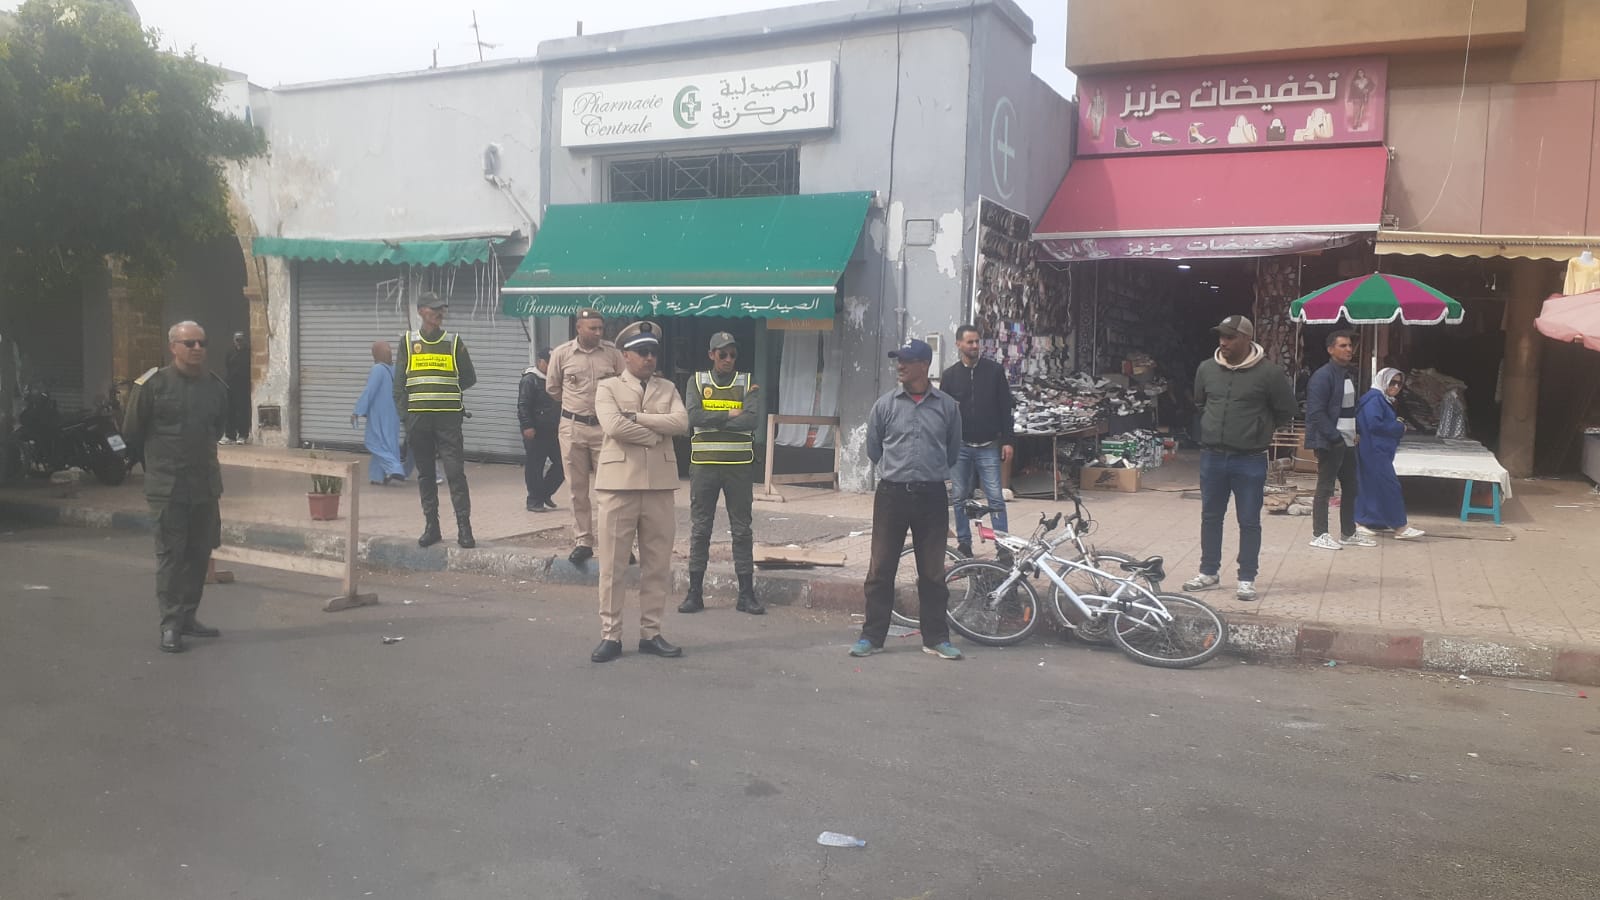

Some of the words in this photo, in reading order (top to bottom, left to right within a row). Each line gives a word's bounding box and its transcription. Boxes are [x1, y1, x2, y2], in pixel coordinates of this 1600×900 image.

[719, 69, 809, 100] الصيدلية
[1190, 71, 1340, 111] تخفيضات
[572, 91, 664, 116] Pharmacie
[711, 91, 816, 129] المركزية
[1120, 83, 1181, 118] عزيز
[580, 113, 652, 137] Centrale
[1124, 242, 1174, 256] عزيز
[1187, 237, 1294, 253] تخفيضات
[588, 294, 644, 314] Centrale
[666, 293, 732, 316] المركزية
[740, 297, 820, 313] الصيدلية
